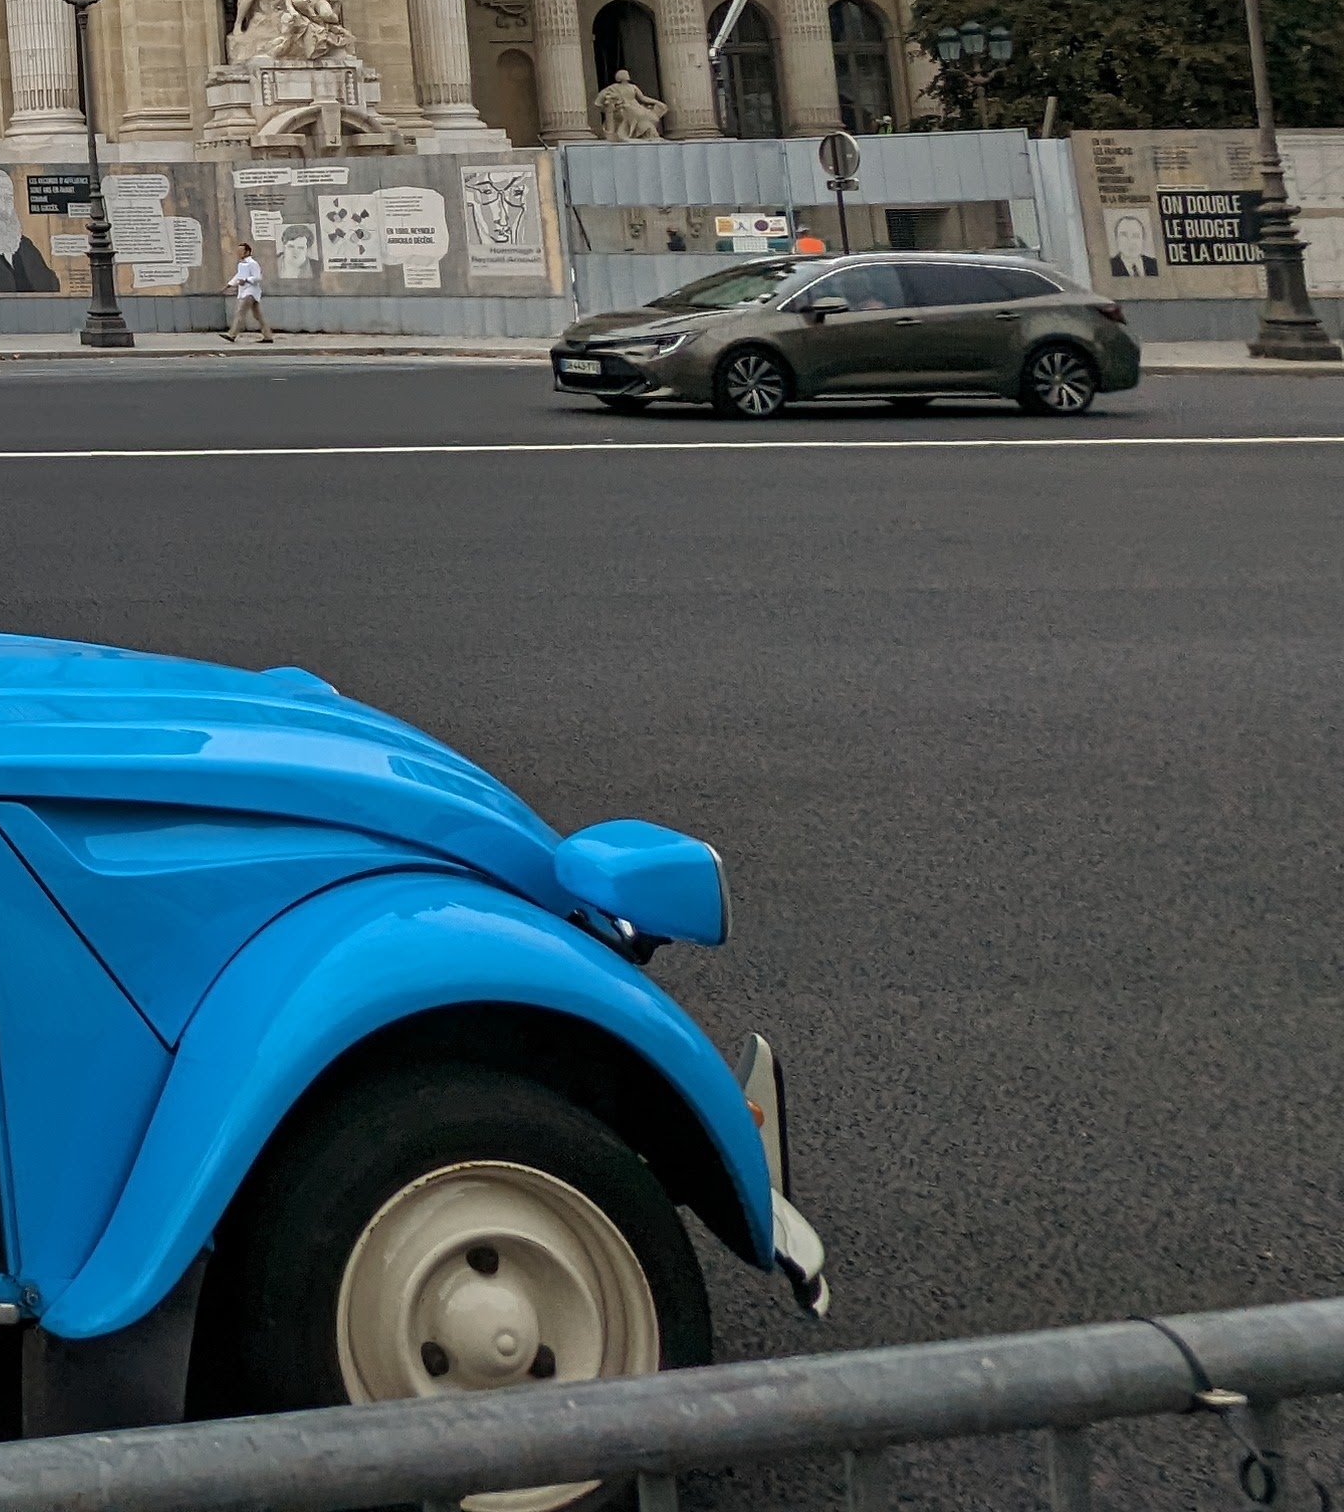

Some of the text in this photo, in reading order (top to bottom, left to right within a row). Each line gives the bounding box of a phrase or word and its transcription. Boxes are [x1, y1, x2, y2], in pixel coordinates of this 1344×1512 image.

[1162, 195, 1242, 214] ON DOUBLE
[1164, 219, 1239, 238] LE BUDGET
[1168, 243, 1264, 262] DE LA CULTUR
